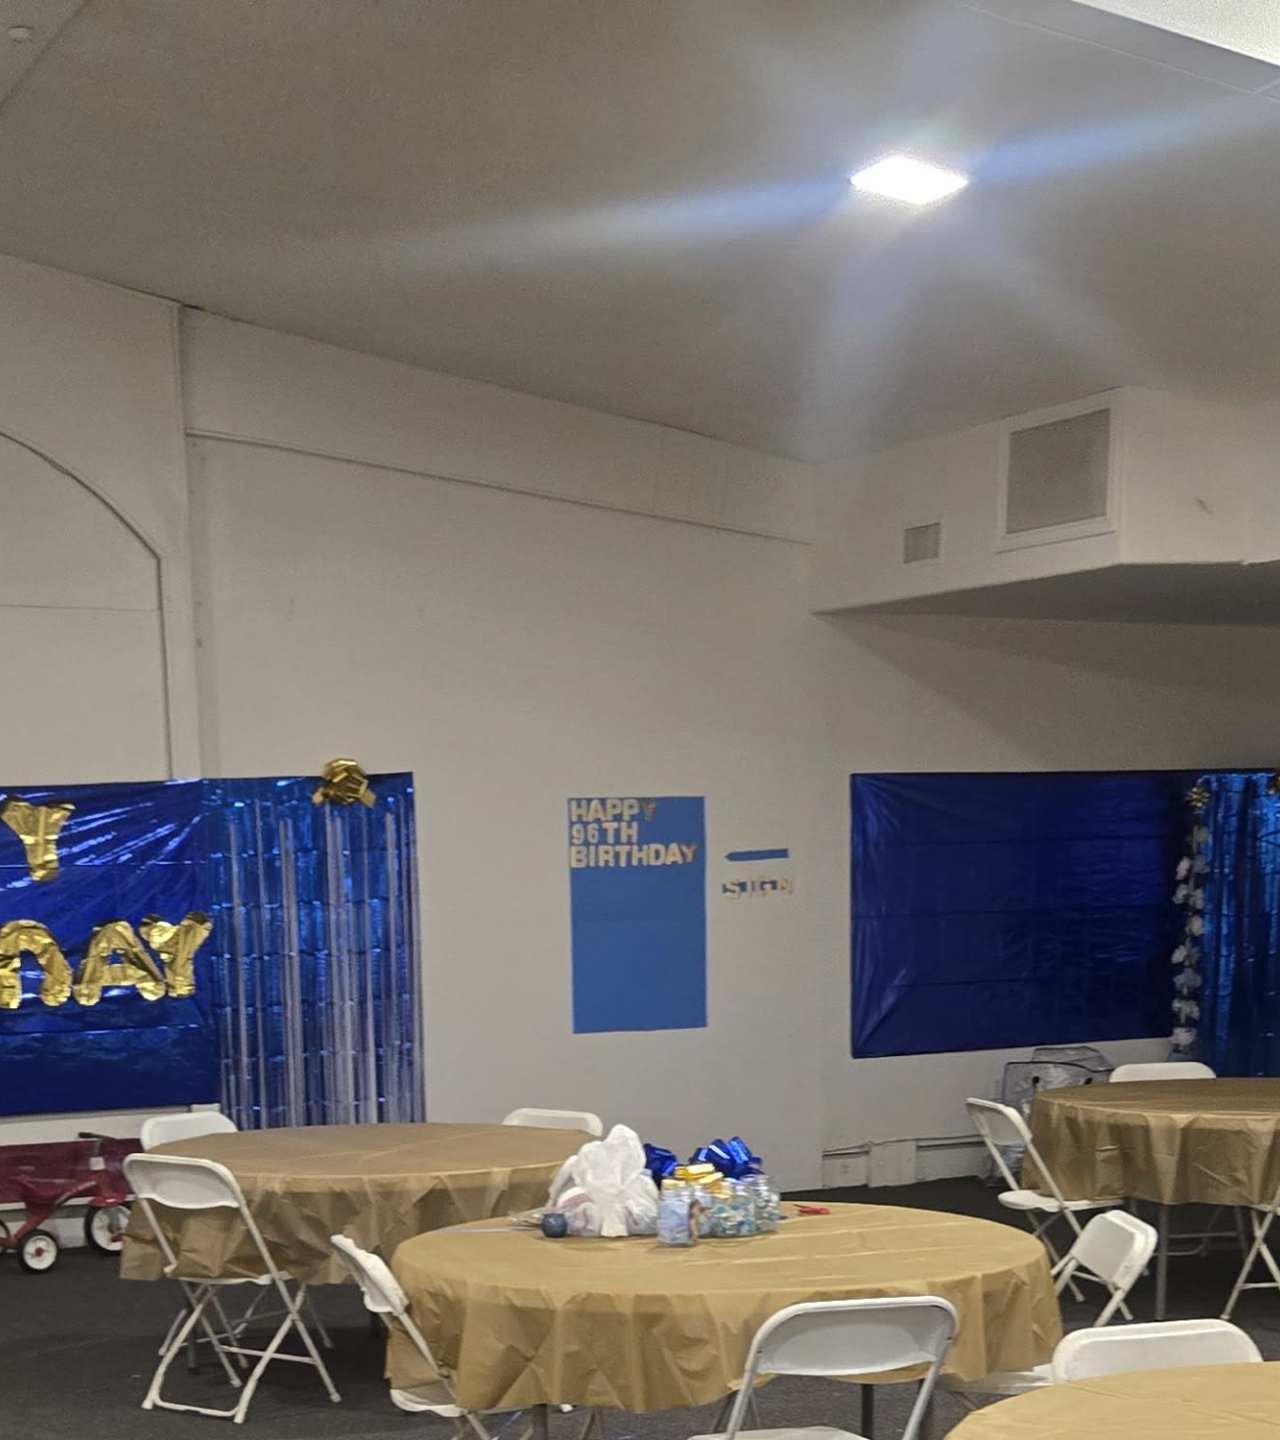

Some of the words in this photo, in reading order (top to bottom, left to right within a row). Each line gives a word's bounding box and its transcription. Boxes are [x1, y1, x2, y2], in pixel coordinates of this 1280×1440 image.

[570, 799, 656, 822] HAPPY
[571, 822, 638, 844] 96TH
[570, 843, 696, 868] BIRTHDAY
